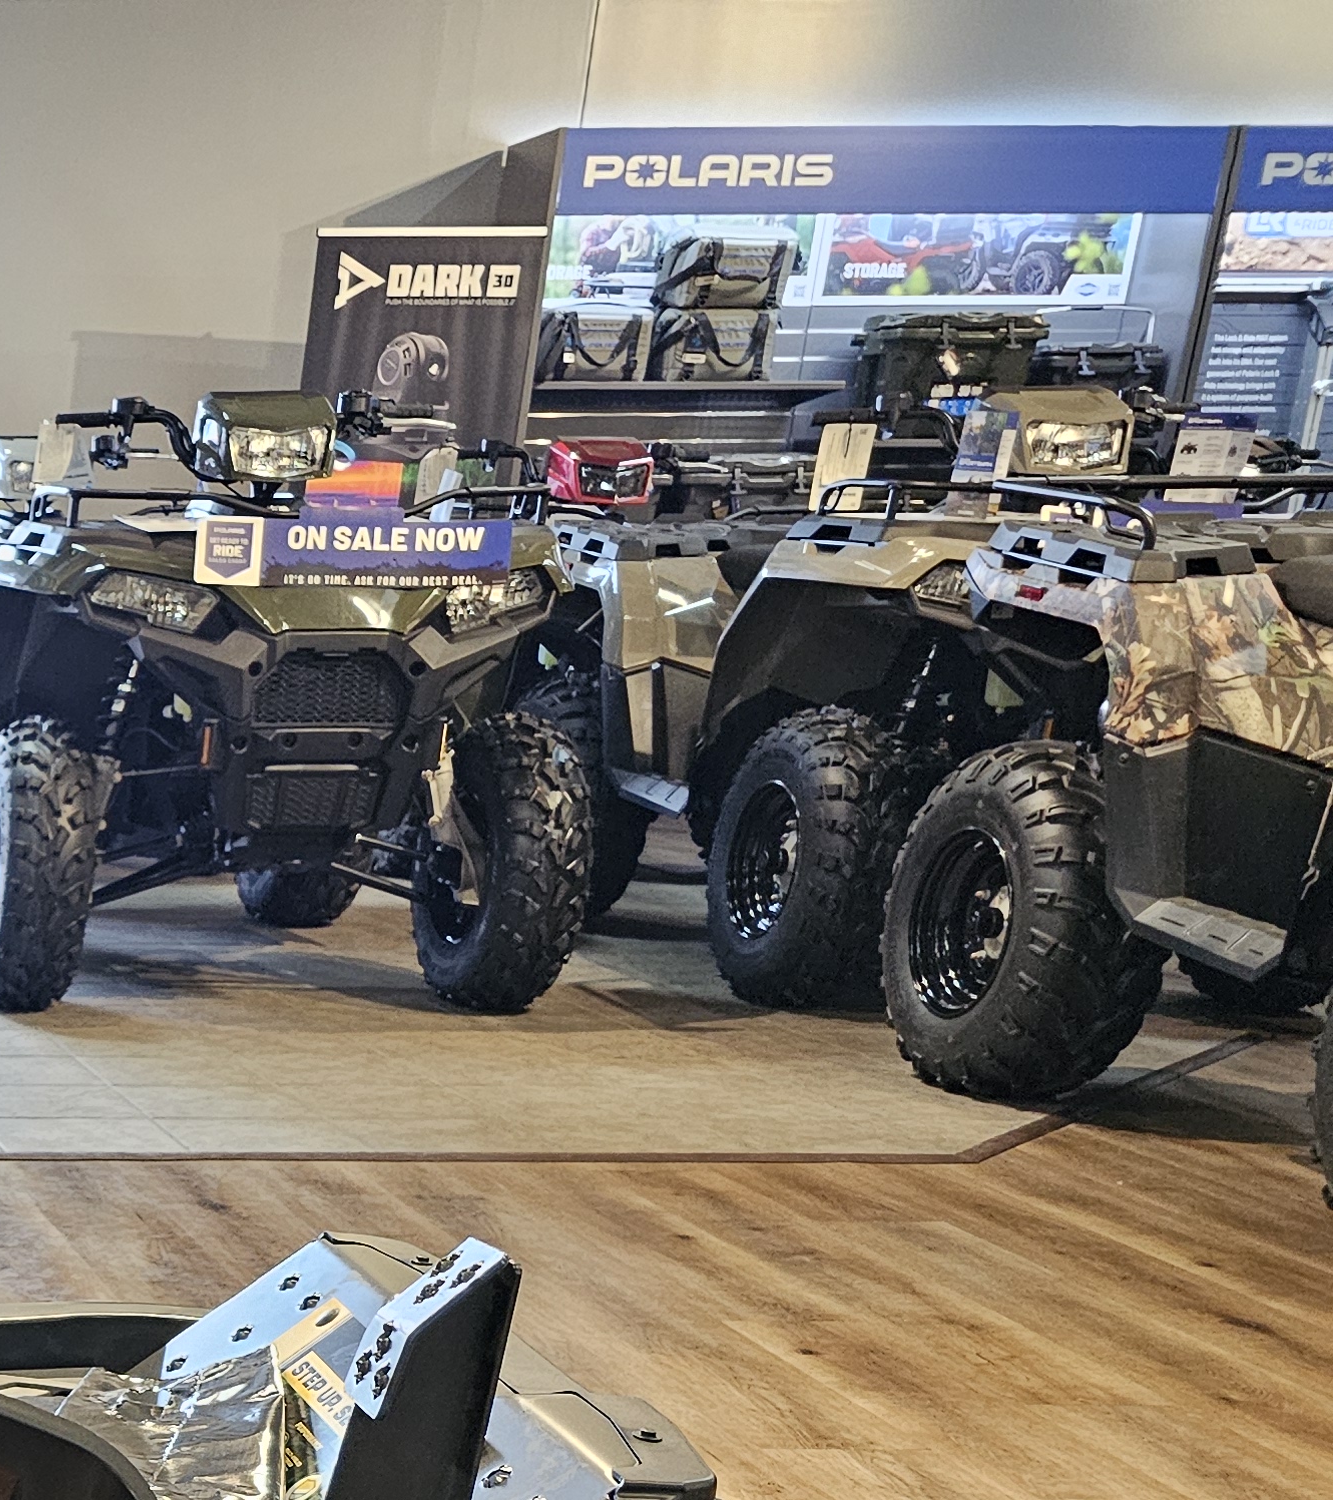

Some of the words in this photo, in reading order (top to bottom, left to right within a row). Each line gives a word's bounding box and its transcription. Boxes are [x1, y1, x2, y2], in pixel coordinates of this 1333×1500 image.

[583, 153, 833, 188] POLARIS
[386, 264, 485, 297] DARK
[844, 262, 907, 279] STORAGE
[213, 544, 245, 558] RIDE
[287, 525, 328, 551] ON
[333, 526, 408, 552] SALE
[415, 526, 484, 552] NOW
[354, 575, 374, 585] ASK
[376, 575, 396, 586] FOR
[399, 575, 420, 586] OUR
[292, 1361, 328, 1392] STEP
